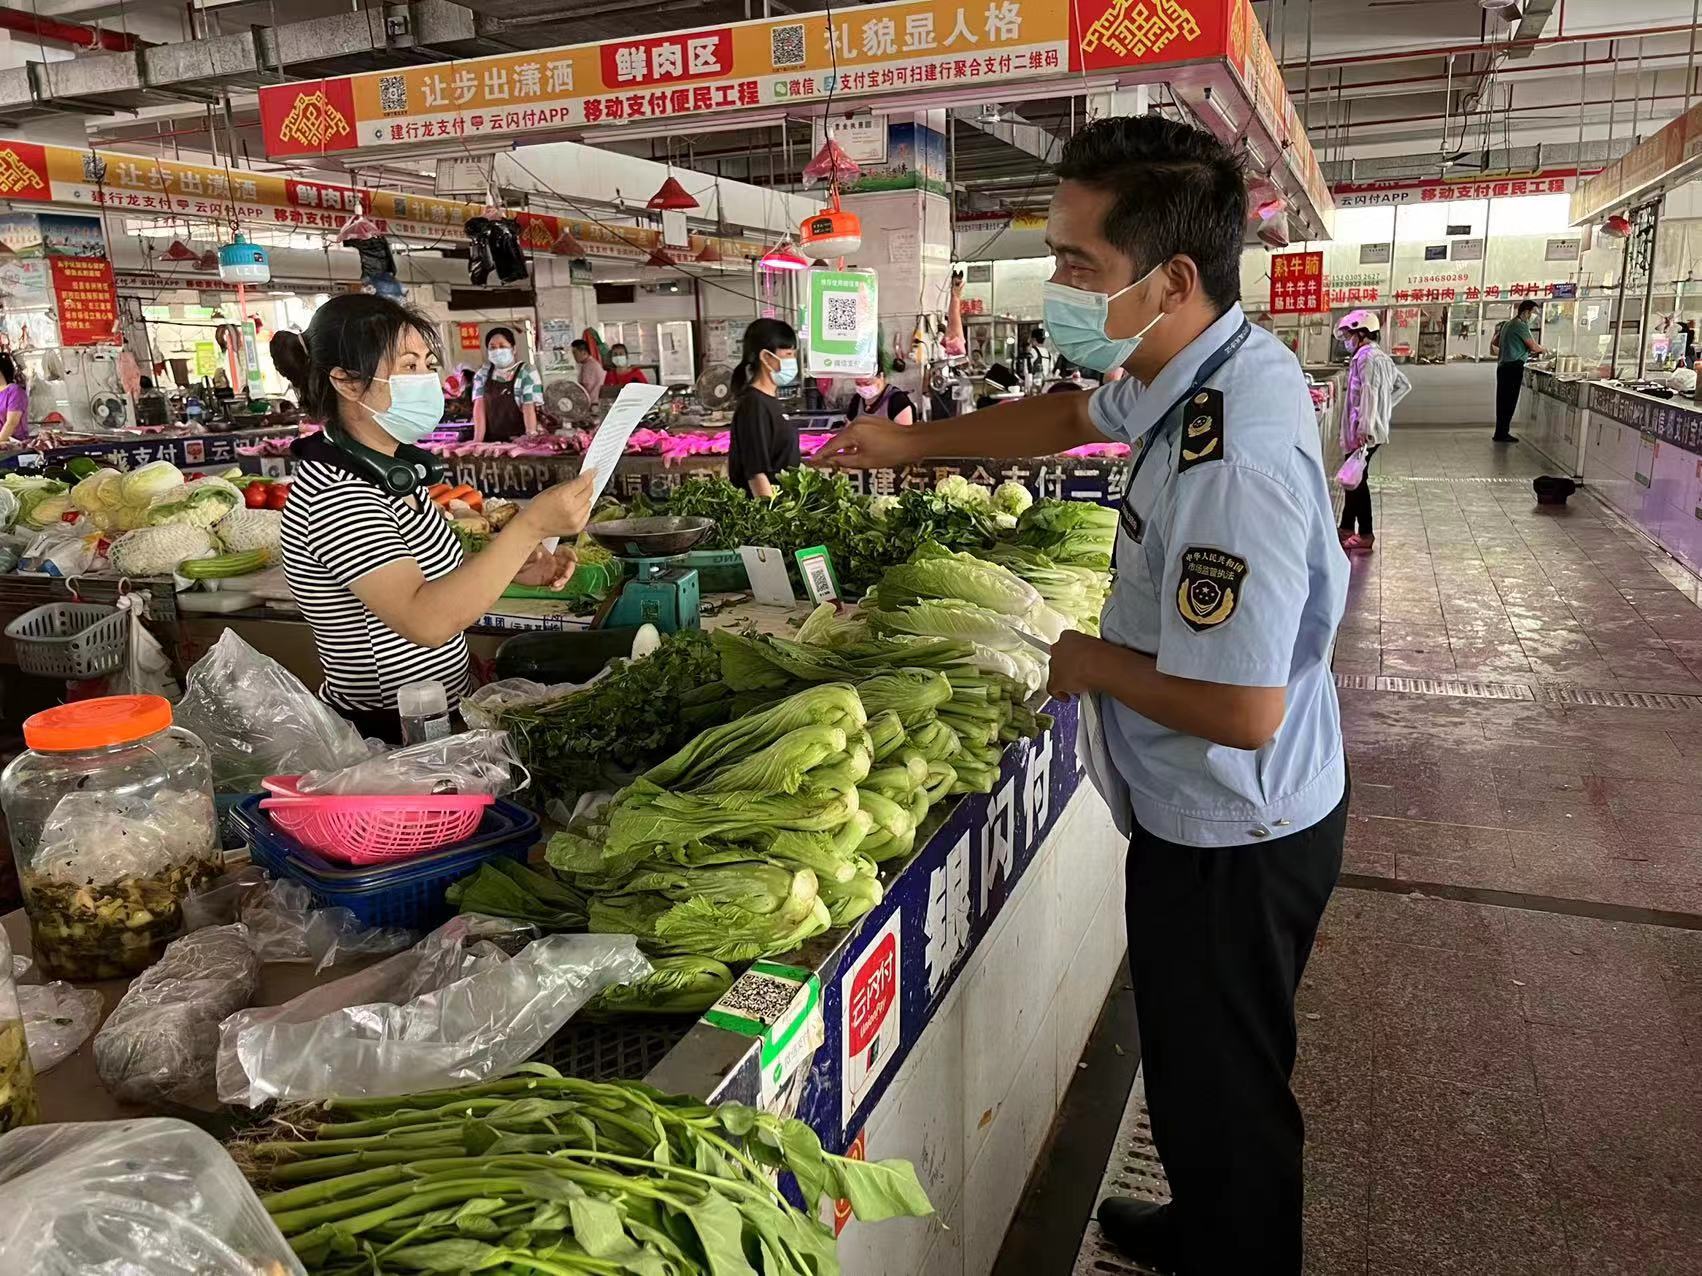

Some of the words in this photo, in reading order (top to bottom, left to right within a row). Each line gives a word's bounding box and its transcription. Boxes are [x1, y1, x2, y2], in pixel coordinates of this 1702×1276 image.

[824, 2, 1023, 60] 礼貌显人格
[615, 36, 721, 82] 鲜肉区
[839, 49, 1059, 92] 支付宝均可扫建行聚合支付二维码
[421, 59, 574, 108] 让步出潇洒
[583, 80, 761, 122] 移动支付便民工程
[390, 117, 466, 141] 建行龙支付
[489, 107, 570, 130] 云闪付APP
[116, 162, 257, 201] 让步出潇洒
[1420, 178, 1565, 202] 移动支付便民工程
[91, 190, 172, 210] 建行龙支付
[194, 202, 264, 217] 云闪付APP
[1341, 192, 1409, 207] 云闪付APP
[1395, 288, 1455, 302] 梅菜扣肉
[1407, 273, 1469, 285] 17384680289
[1185, 552, 1245, 573] 中华人民共和国
[1188, 562, 1235, 581] 市场监管执法
[853, 951, 893, 1027] 云闪付
